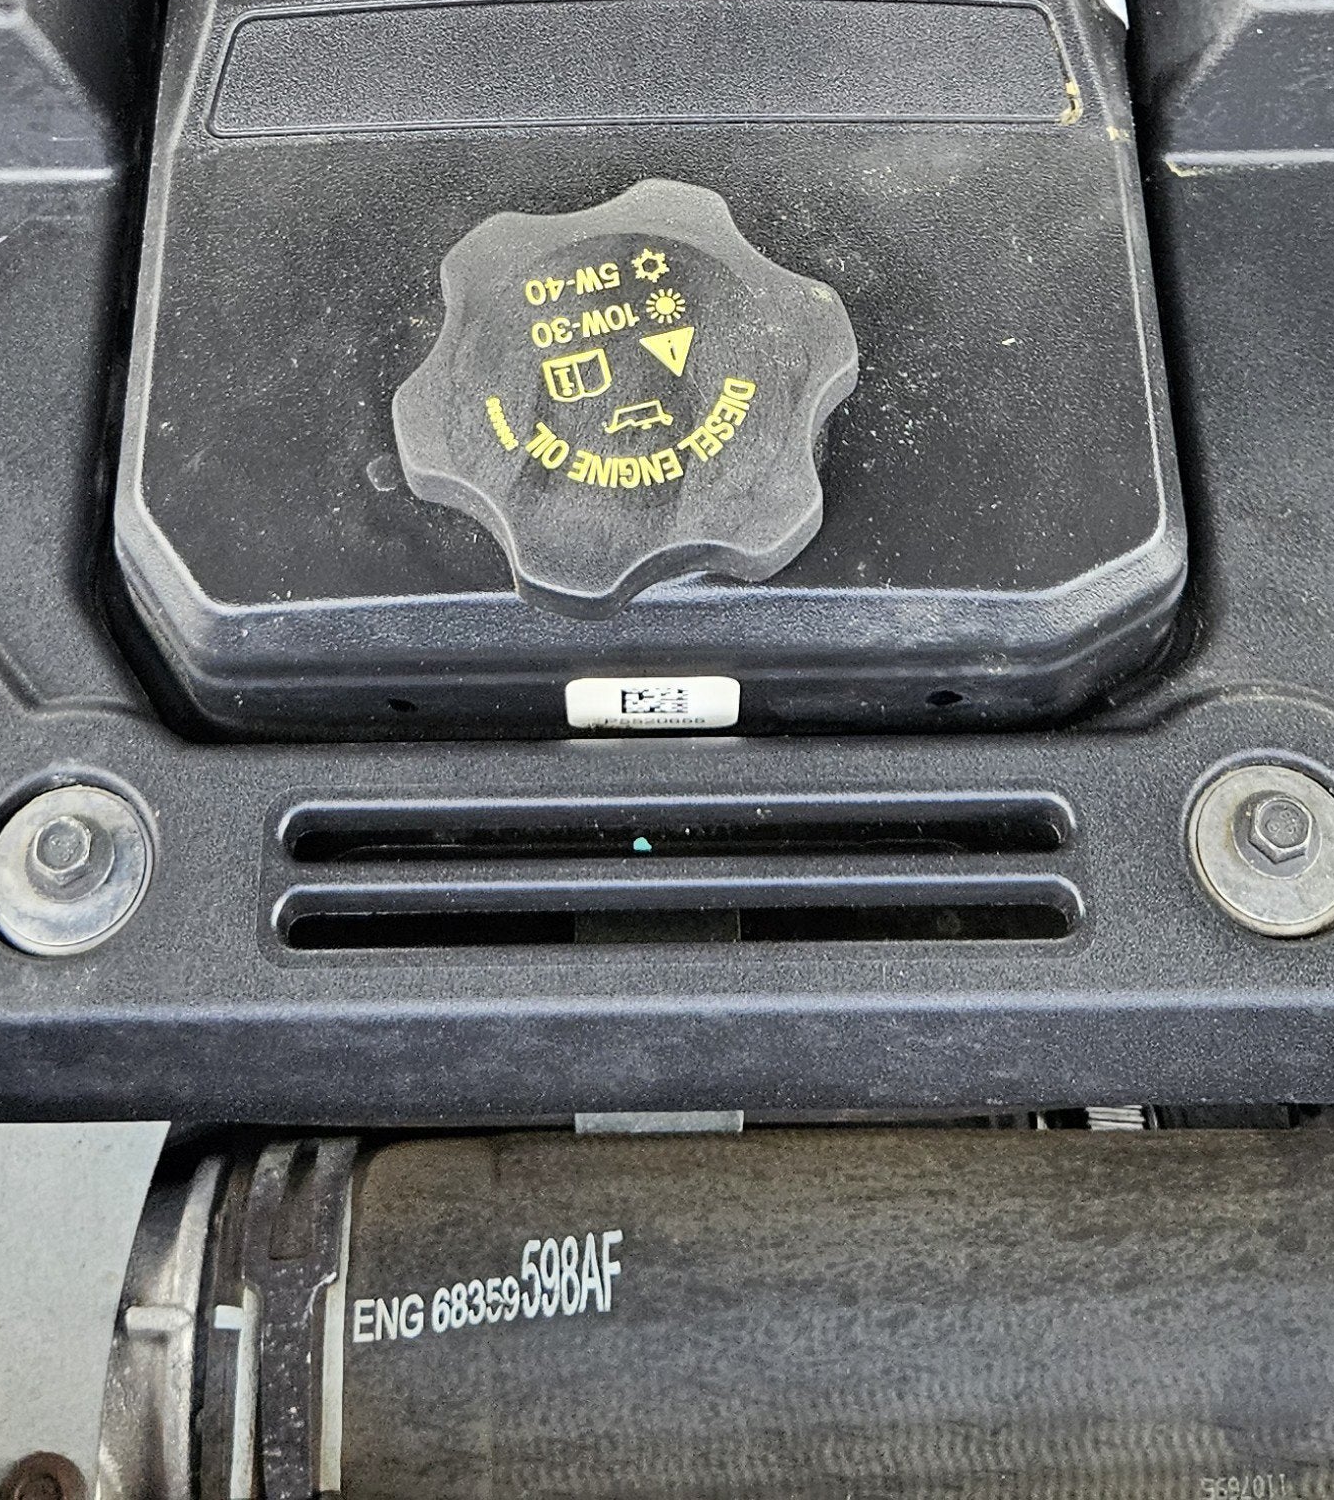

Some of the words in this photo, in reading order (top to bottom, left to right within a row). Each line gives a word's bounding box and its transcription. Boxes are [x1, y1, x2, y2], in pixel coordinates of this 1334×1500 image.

[525, 262, 621, 306] 5W-40
[531, 302, 640, 348] 10W-30
[677, 376, 757, 463] DIESEL
[525, 421, 571, 470] OIL
[567, 448, 684, 489] ENGINE
[353, 1293, 424, 1343] ENG
